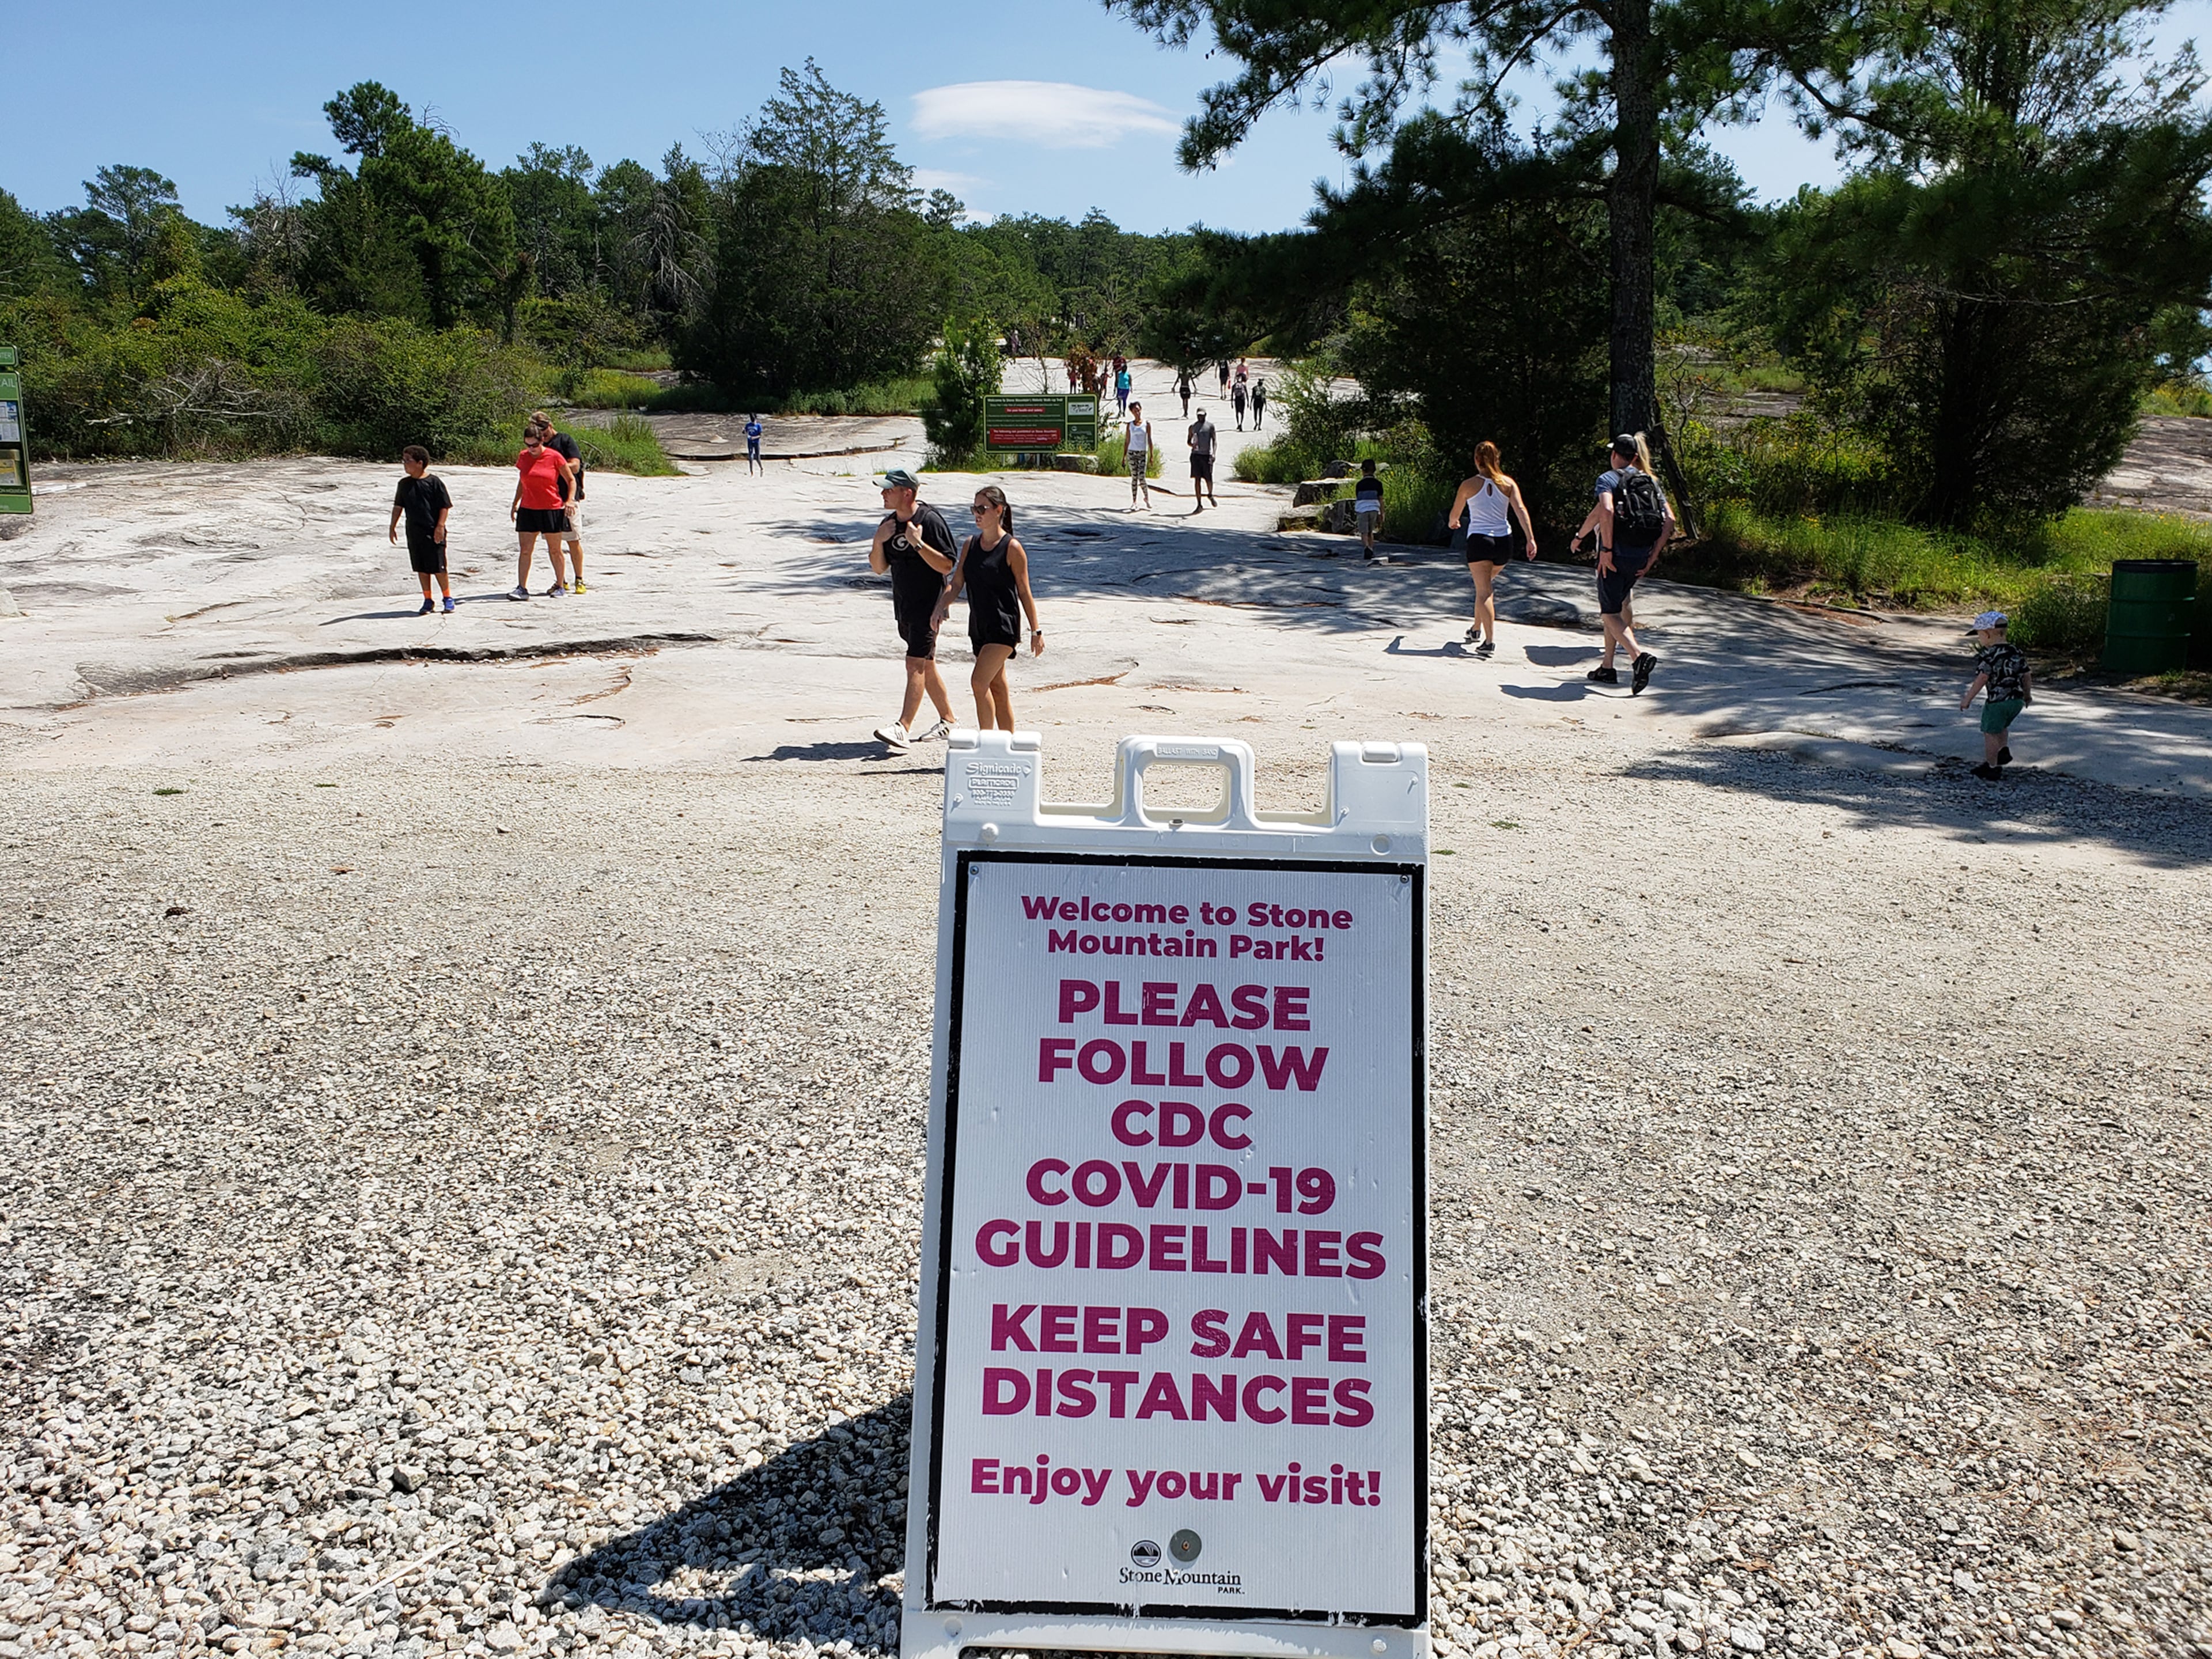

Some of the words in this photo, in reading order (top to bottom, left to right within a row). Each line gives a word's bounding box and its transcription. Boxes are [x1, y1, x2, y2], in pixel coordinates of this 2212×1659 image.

[0, 378, 16, 388] AIL
[965, 762, 1022, 776] Signicade
[1157, 747, 1182, 756] BALLAST
[1185, 748, 1199, 756] WITH
[1202, 748, 1217, 757] SAND
[1022, 897, 1188, 923] Welcome
[1201, 903, 1236, 925] to
[1249, 903, 1352, 929] Stone
[1049, 930, 1217, 957] Mountain
[1230, 935, 1324, 960] Park!
[1059, 980, 1310, 1030] PLEASE
[1039, 1039, 1328, 1091] FOLLOW
[1111, 1100, 1252, 1150] CDC
[1027, 1158, 1335, 1214] COVID-19
[976, 1219, 1386, 1279] GUIDELINES
[991, 1304, 1168, 1354] KEEP
[1191, 1309, 1366, 1362] SAFE
[982, 1368, 1374, 1427] DISTANCES
[971, 1455, 1111, 1506] Enjoy
[1126, 1470, 1241, 1507] your
[1257, 1462, 1380, 1506] visit!
[1163, 1569, 1242, 1586] Mountain
